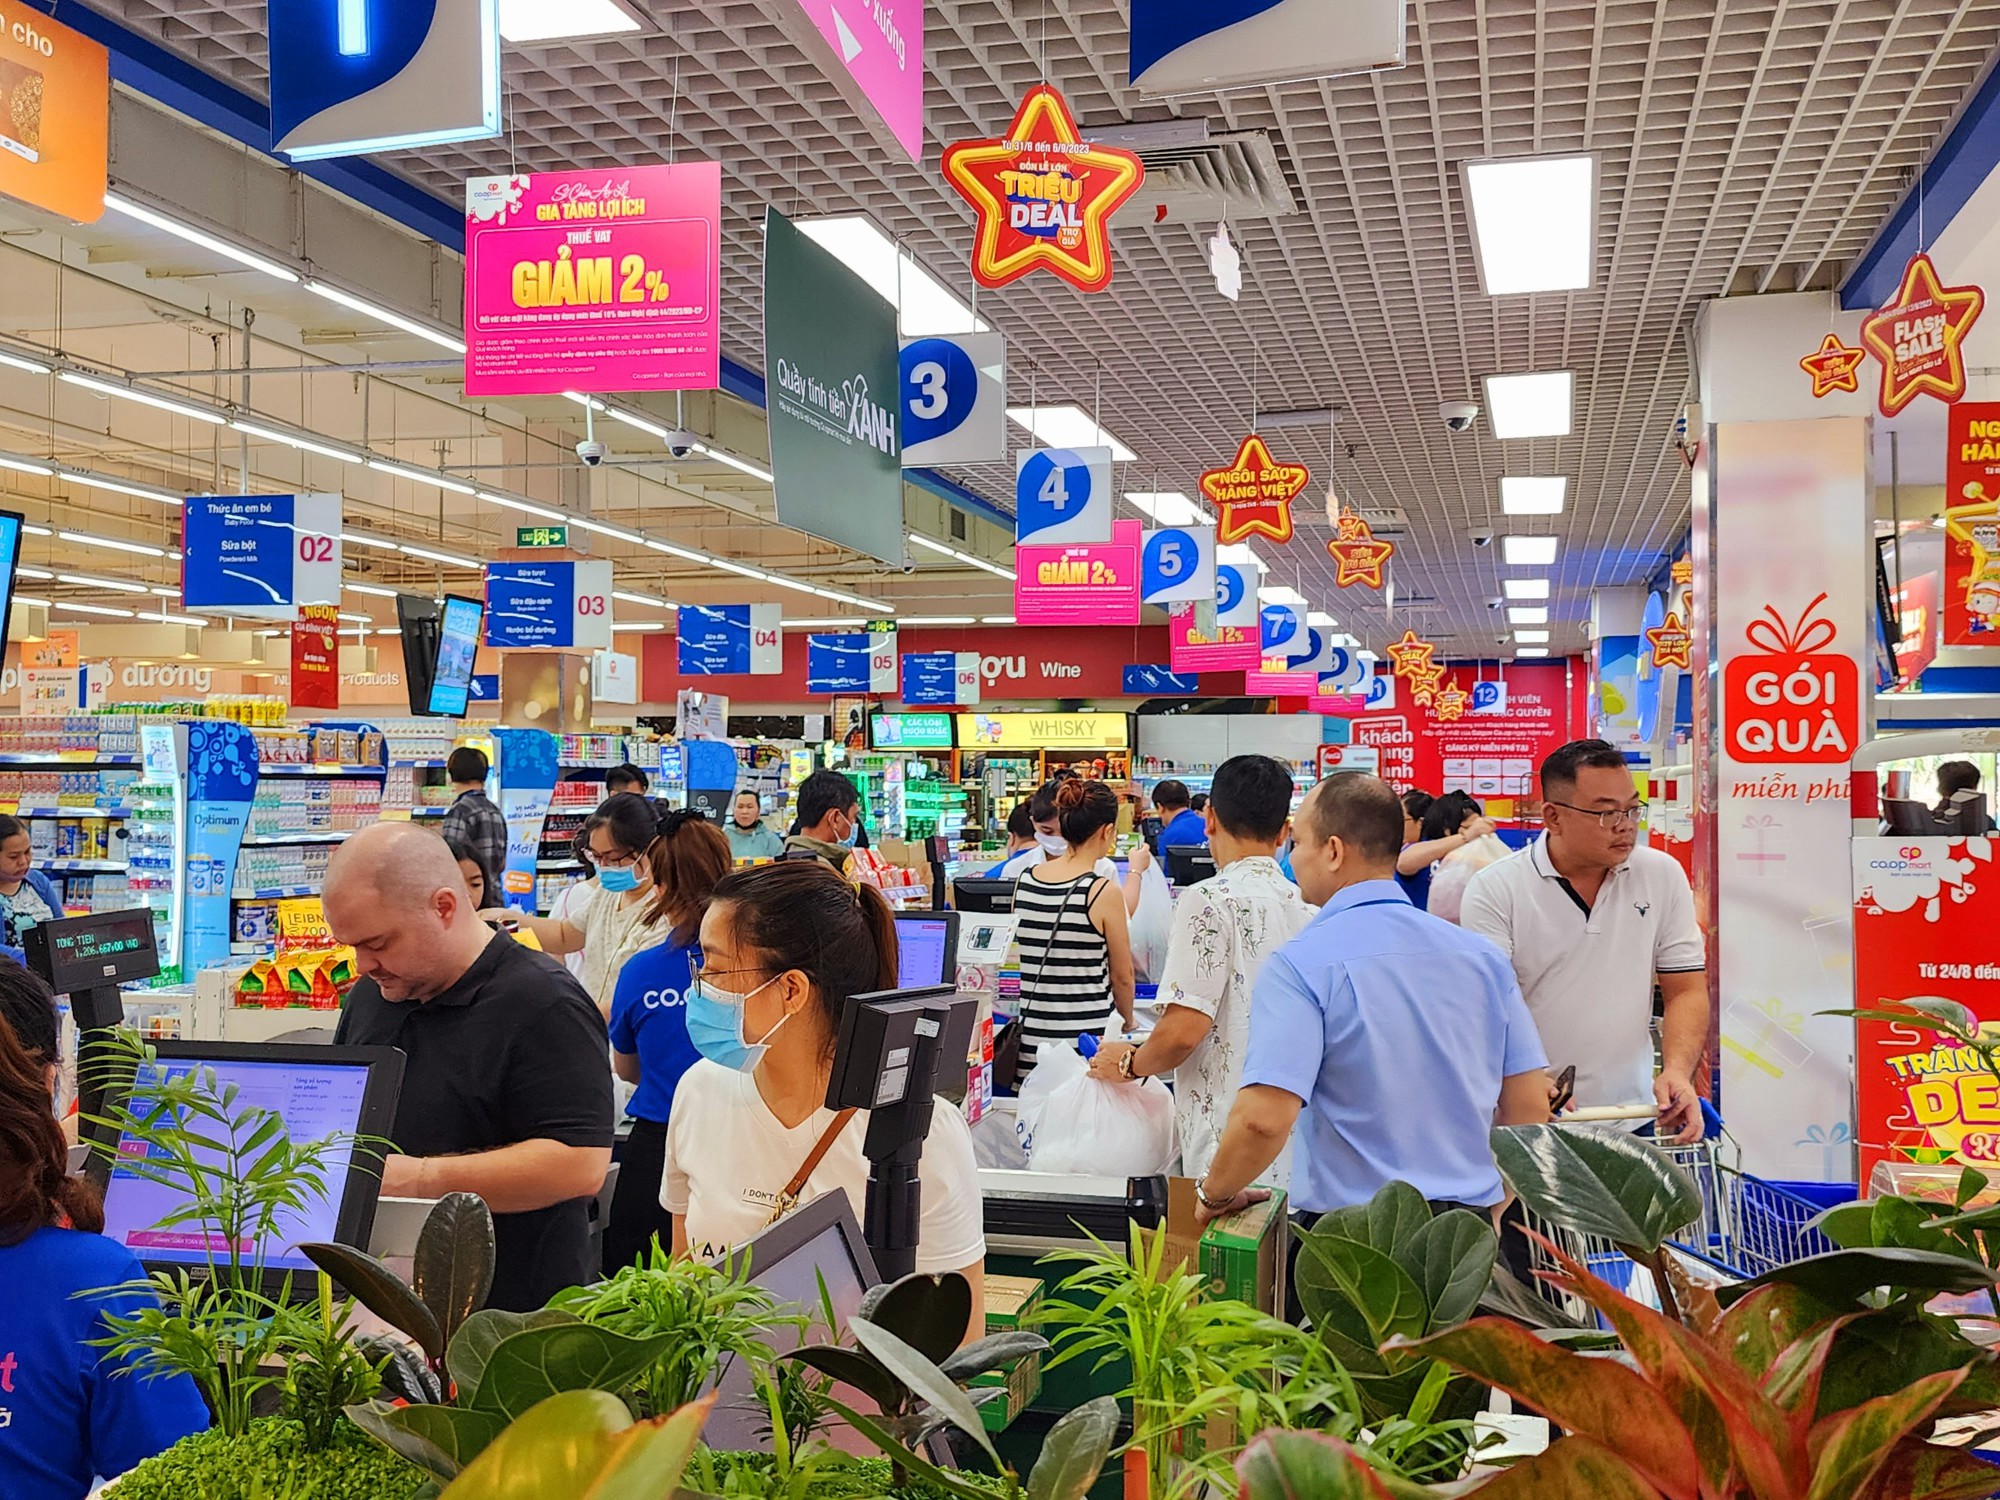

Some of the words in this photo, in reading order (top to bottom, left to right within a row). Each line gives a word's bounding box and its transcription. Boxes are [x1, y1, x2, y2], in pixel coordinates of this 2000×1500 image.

[12, 21, 54, 57] cho
[1035, 141, 1050, 153] đến
[1000, 170, 1083, 203] TRIỆU
[536, 202, 561, 221] GIA
[563, 200, 597, 219] TĂNG
[599, 199, 621, 220] LỢI
[1010, 204, 1083, 228] DEAL
[566, 228, 592, 245] THUẾ
[594, 229, 612, 243] VAT
[512, 245, 613, 308] GIẢM
[620, 254, 670, 303] 2%
[1894, 314, 1946, 344] FLASH
[1895, 327, 1945, 363] SALE
[777, 358, 806, 403] Quầy
[808, 376, 827, 409] tính
[828, 386, 846, 420] tiền
[909, 361, 948, 419] 3
[847, 388, 896, 457] XANH
[1220, 468, 1255, 484] NGÔI
[1260, 467, 1290, 481] SAO
[1038, 467, 1069, 510] 4
[1216, 485, 1257, 501] HÀNG
[1261, 481, 1295, 499] VIỆT
[207, 504, 230, 514] Thức
[232, 504, 243, 513] ăn
[245, 505, 259, 513] em
[260, 503, 272, 513] bé
[221, 540, 240, 551] Sữa
[241, 540, 256, 552] bột
[300, 536, 333, 562] 02
[1158, 543, 1182, 577] 5
[1038, 555, 1089, 585] GIẢM
[1091, 561, 1117, 584] 2%
[305, 605, 337, 623] NGON
[578, 596, 605, 615] 03
[1262, 612, 1285, 638] 7
[755, 630, 777, 647] 04
[873, 656, 892, 669] 05
[1040, 662, 1081, 678] Wine
[958, 673, 975, 684] 06
[1745, 661, 1836, 706] GÓI
[91, 682, 102, 693] 12
[1477, 688, 1496, 702] 12
[1517, 694, 1541, 704] VIÊN
[1516, 706, 1551, 717] QUYỀN
[1029, 720, 1096, 736] WHISKY
[1359, 728, 1414, 744] khách
[1736, 708, 1848, 753] QUÀ
[1731, 773, 1799, 799] miễn
[194, 814, 239, 828] Optimum
[510, 843, 534, 855] Mới
[56, 937, 75, 949] TONG
[1918, 963, 1937, 978] Từ
[1939, 964, 1972, 979] 24/8
[128, 1145, 137, 1153] F4
[749, 1189, 775, 1200] DON'T
